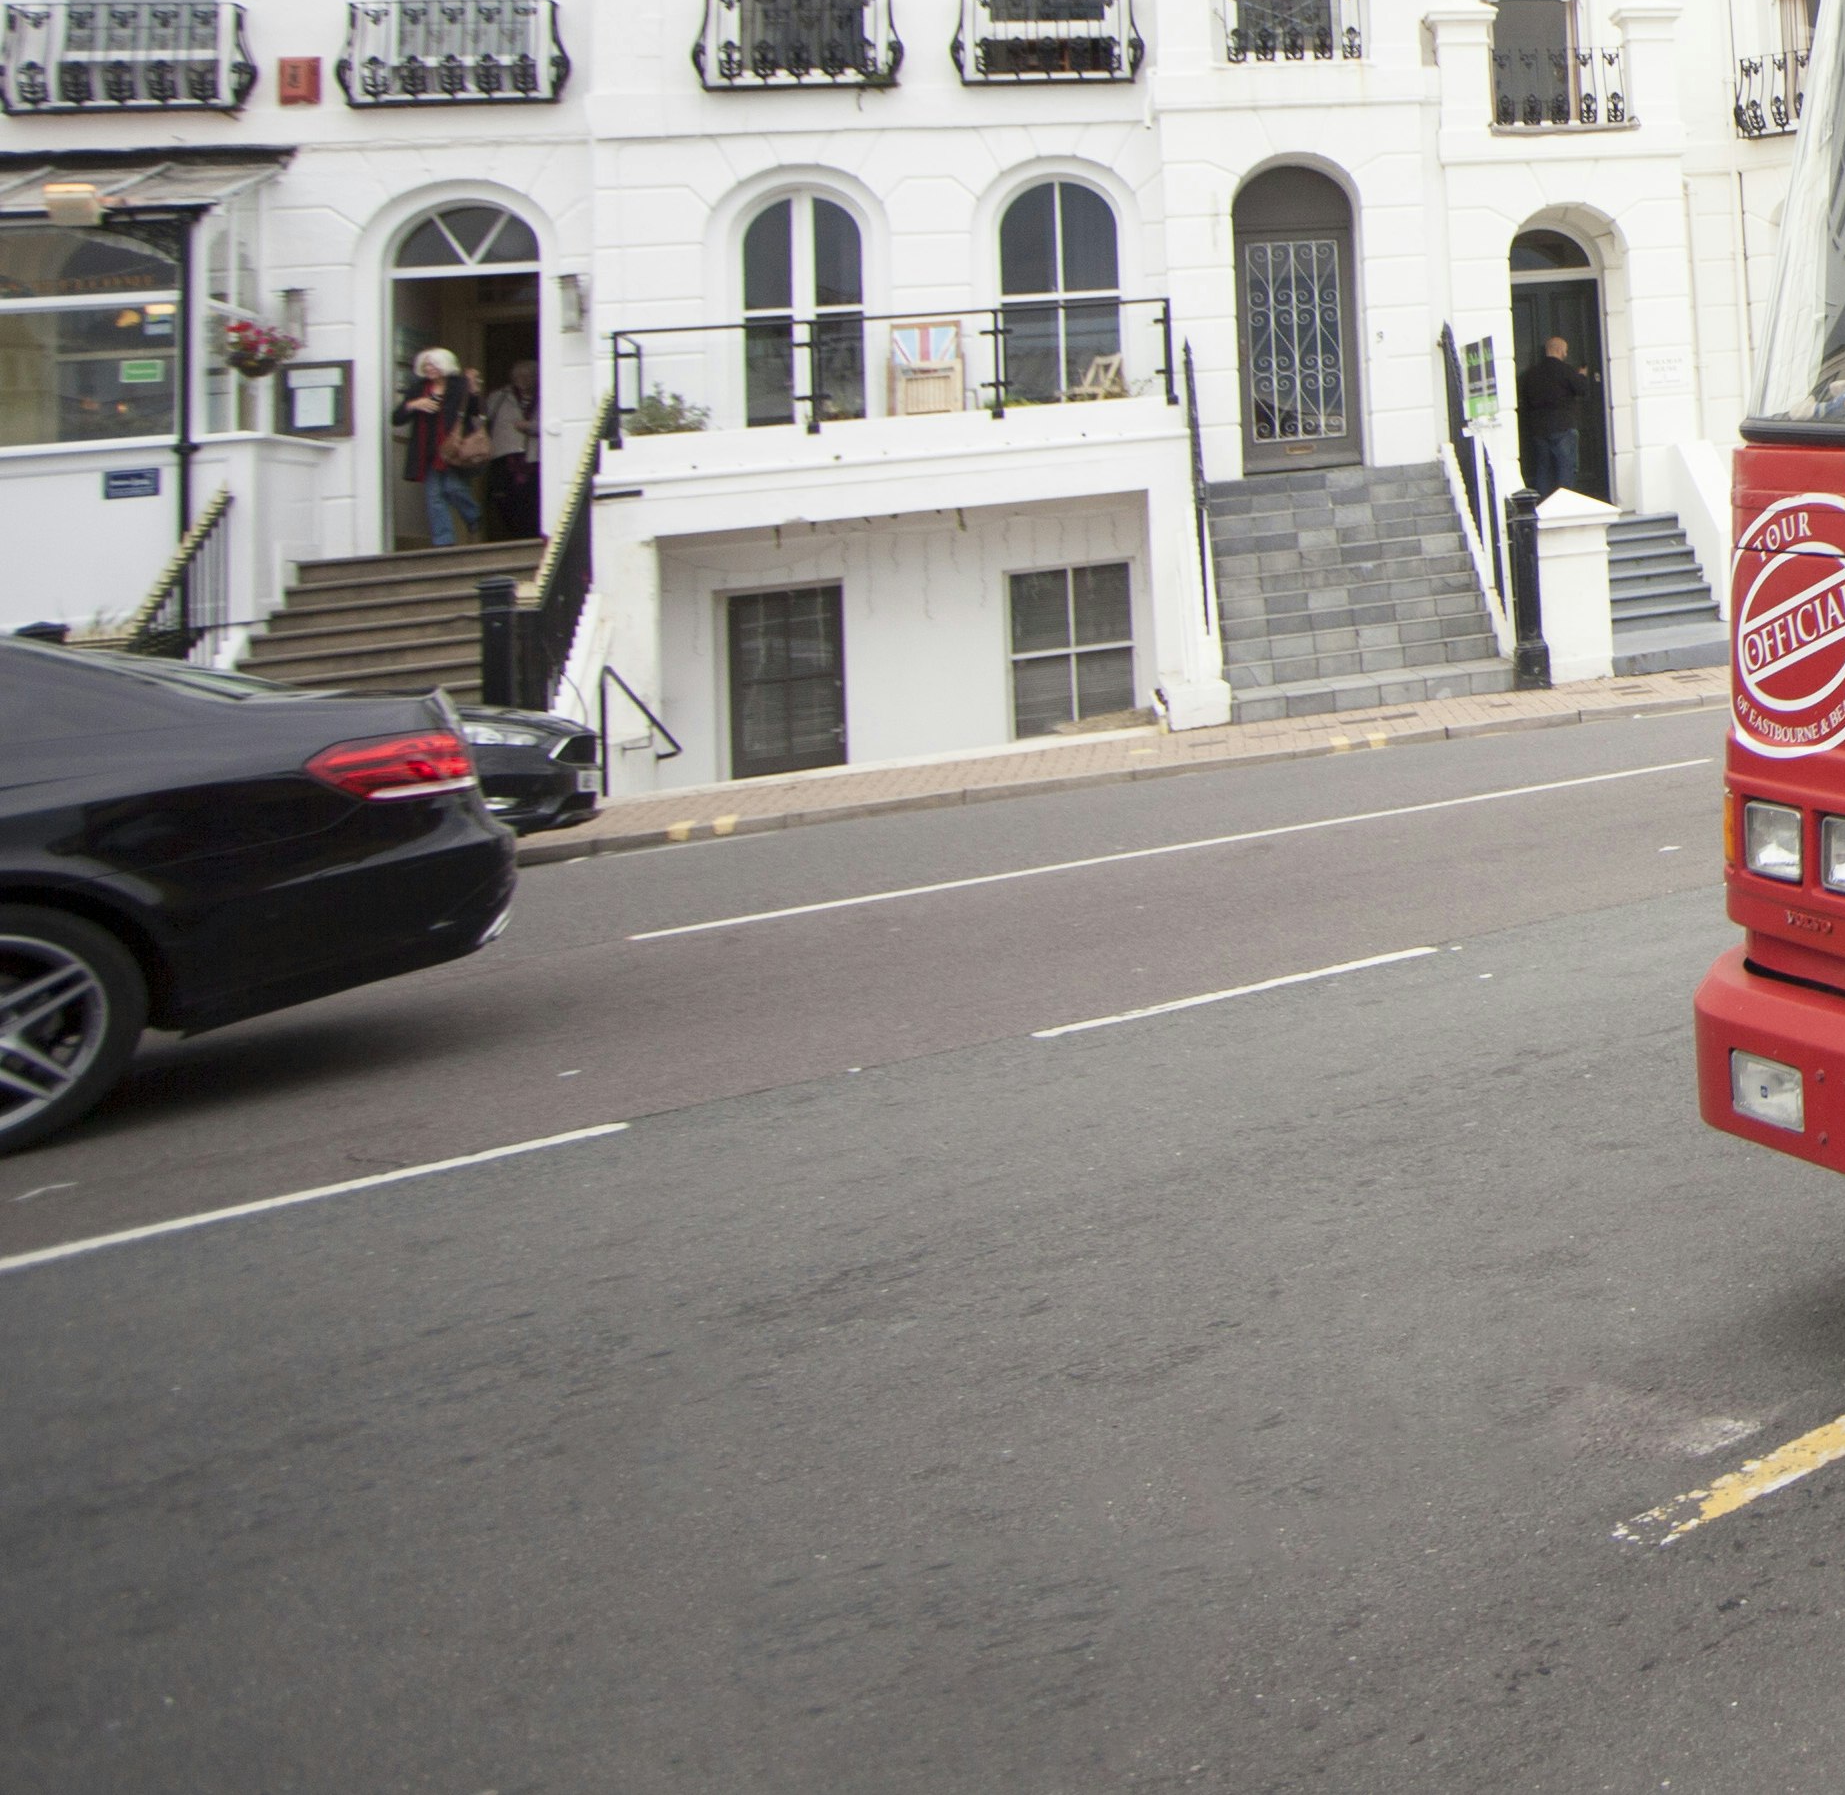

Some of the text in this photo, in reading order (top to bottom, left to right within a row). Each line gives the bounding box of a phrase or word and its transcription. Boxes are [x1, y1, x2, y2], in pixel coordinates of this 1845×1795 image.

[1753, 511, 1813, 563] TOUR
[1736, 694, 1750, 717] OF
[1749, 711, 1820, 743] EASTBOURNE
[1820, 717, 1830, 734] &
